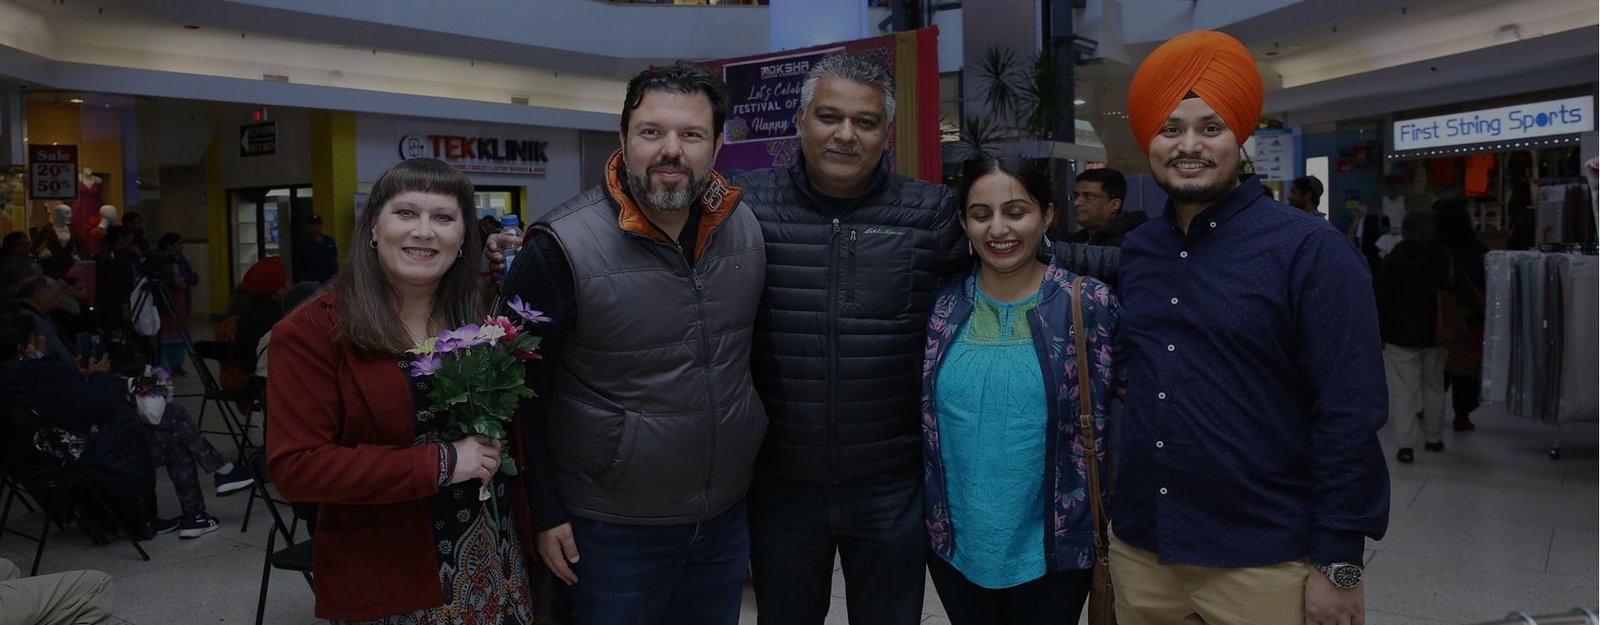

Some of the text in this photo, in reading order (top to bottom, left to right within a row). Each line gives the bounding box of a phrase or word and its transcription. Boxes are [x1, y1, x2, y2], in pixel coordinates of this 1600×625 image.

[760, 61, 809, 77] MOKSHA
[733, 99, 799, 114] FESTIVAL OF
[752, 117, 788, 136] Happy
[1400, 105, 1582, 142] First String Sports
[37, 149, 71, 161] Sale
